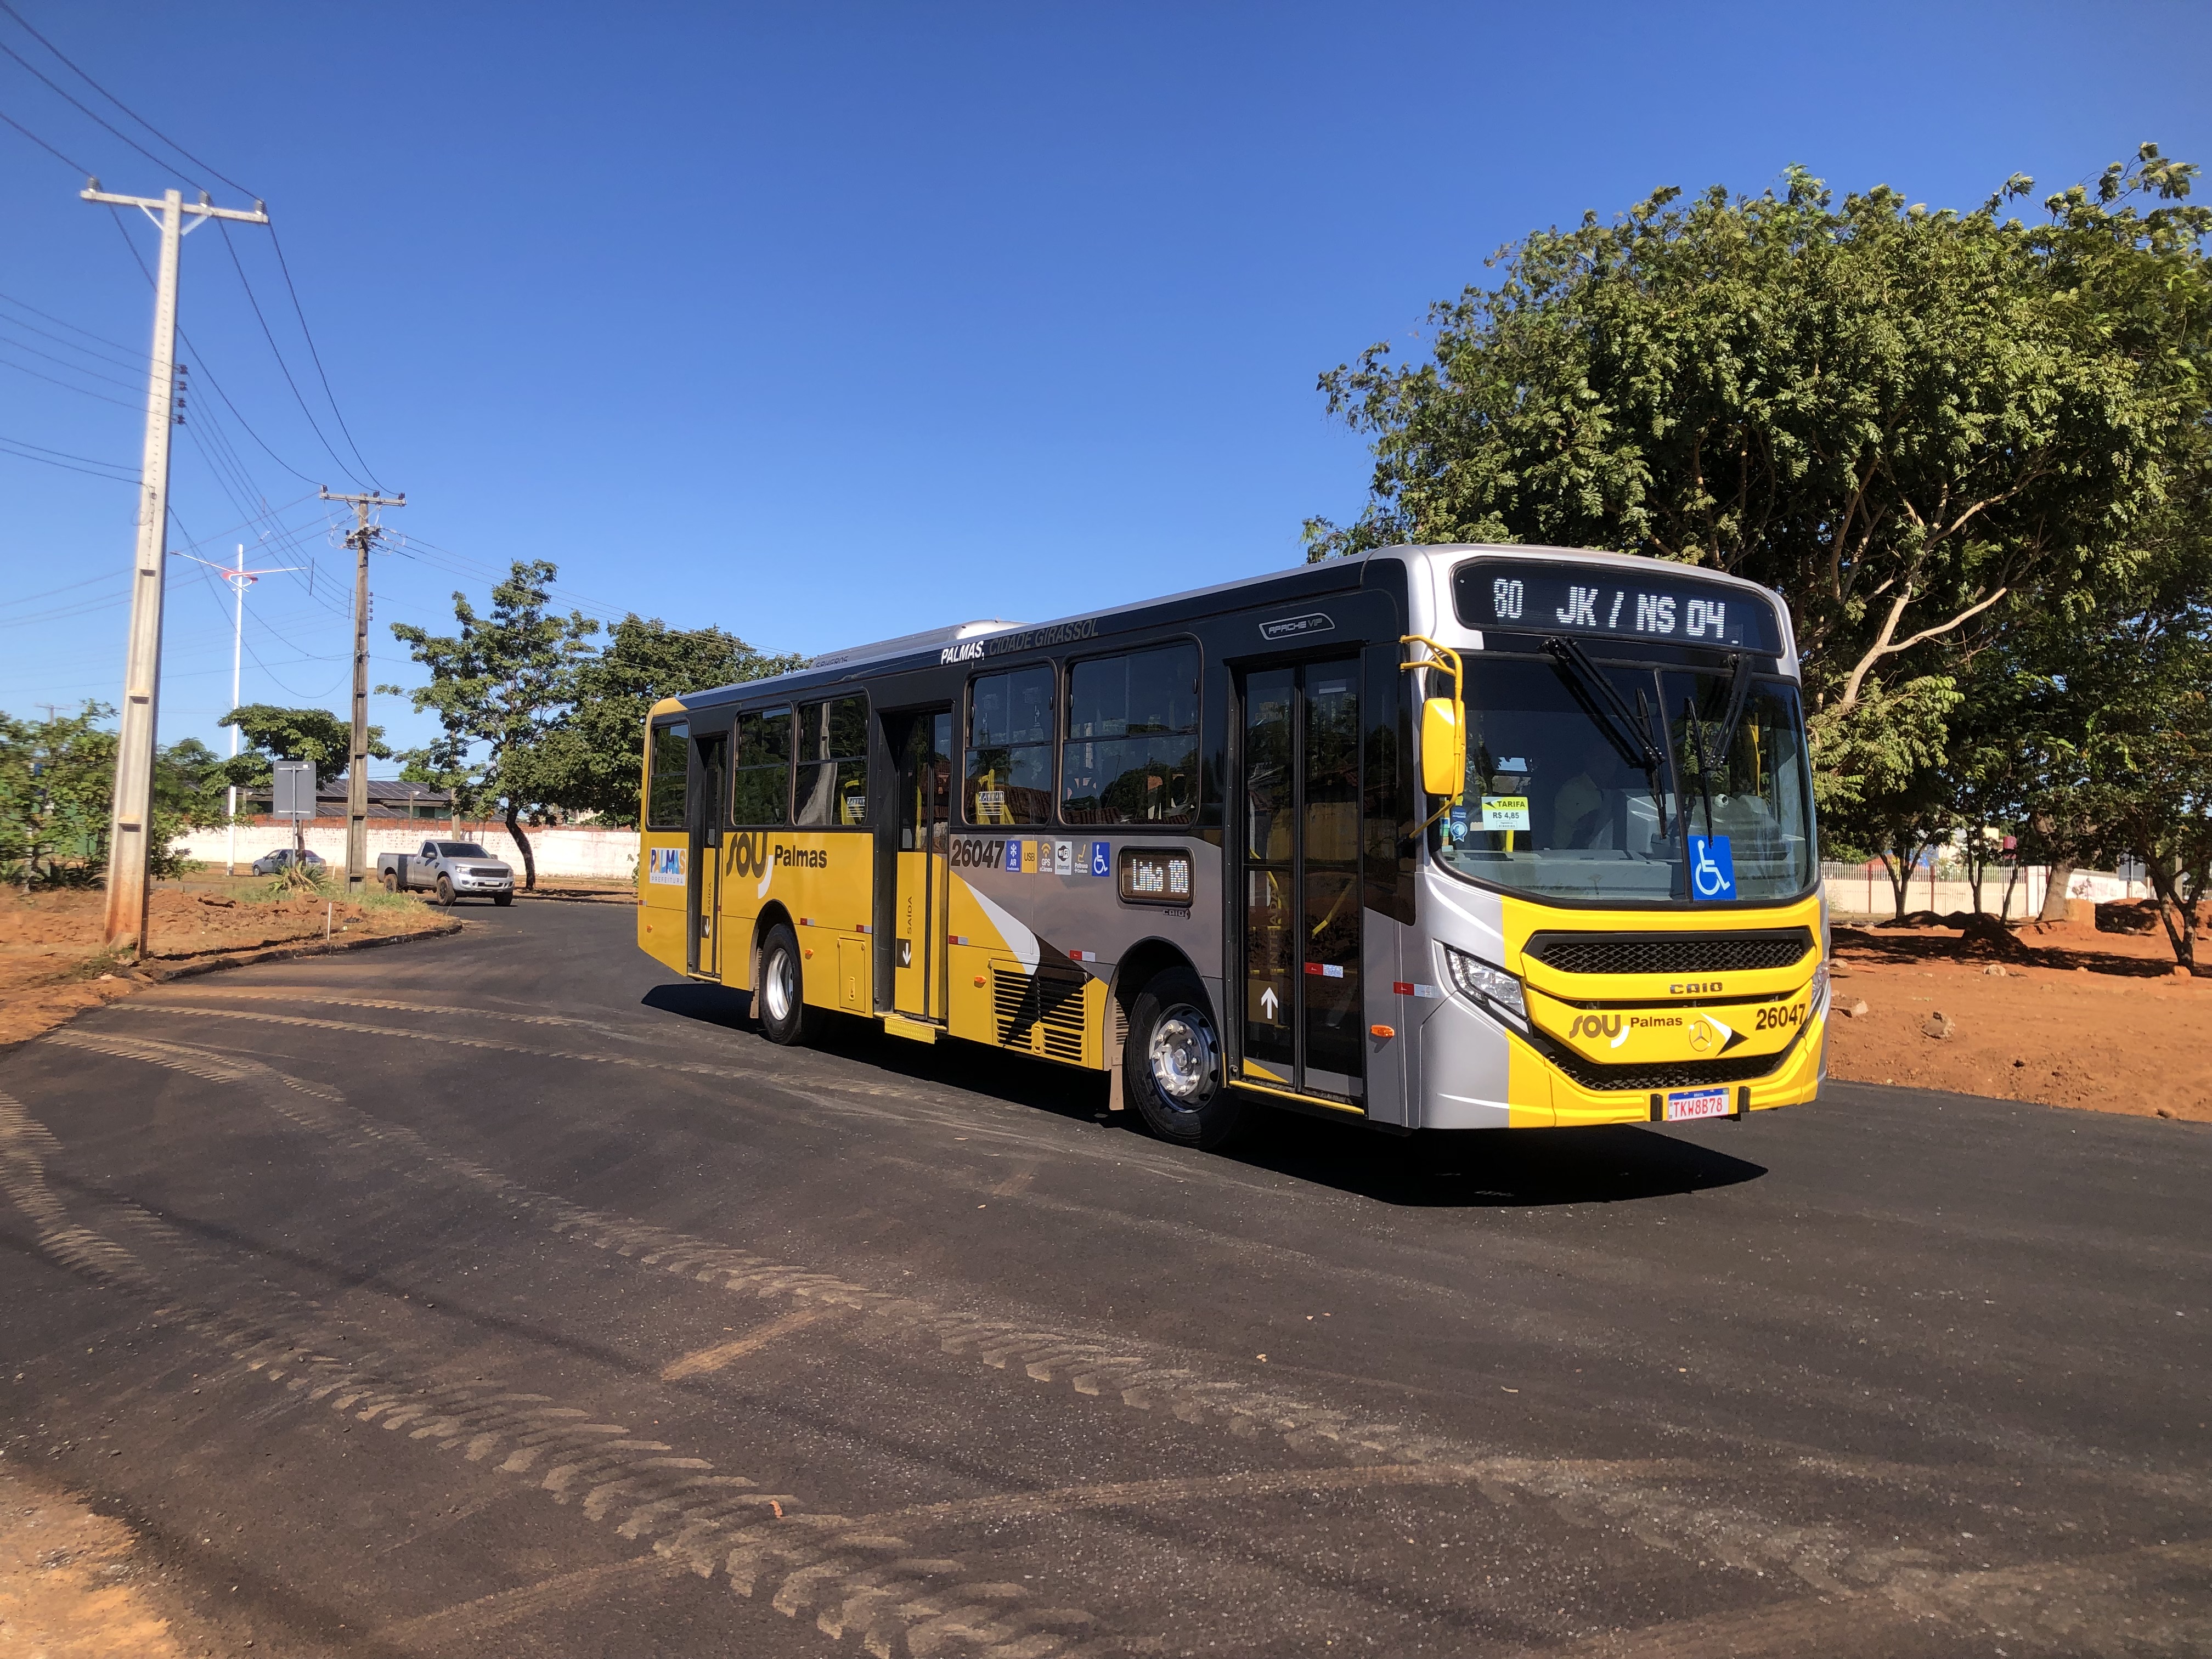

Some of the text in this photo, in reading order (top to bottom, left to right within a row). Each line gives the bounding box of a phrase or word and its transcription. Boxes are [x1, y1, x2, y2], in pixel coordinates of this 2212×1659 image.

[1493, 579, 1725, 639] 80 JK / NS 04
[1268, 618, 1323, 635] APACHE VIP
[941, 618, 1099, 665] PALMAS, CIDADE GIRASSOL
[1504, 812, 1520, 820] 4,85
[651, 849, 686, 875] PALMAS
[774, 844, 827, 868] Palmas
[950, 839, 1006, 869] 26047
[1009, 858, 1017, 866] AR
[1024, 852, 1035, 862] USB
[1041, 858, 1051, 866] GPS
[651, 876, 684, 884] PREFEITURA
[1132, 859, 1164, 891] Linha
[1163, 909, 1185, 917] CAIO
[1669, 981, 1723, 995] CAIO
[1630, 1016, 1683, 1028] Palmas
[1755, 1003, 1806, 1031] 26047
[1673, 1097, 1723, 1118] TKW8B78
